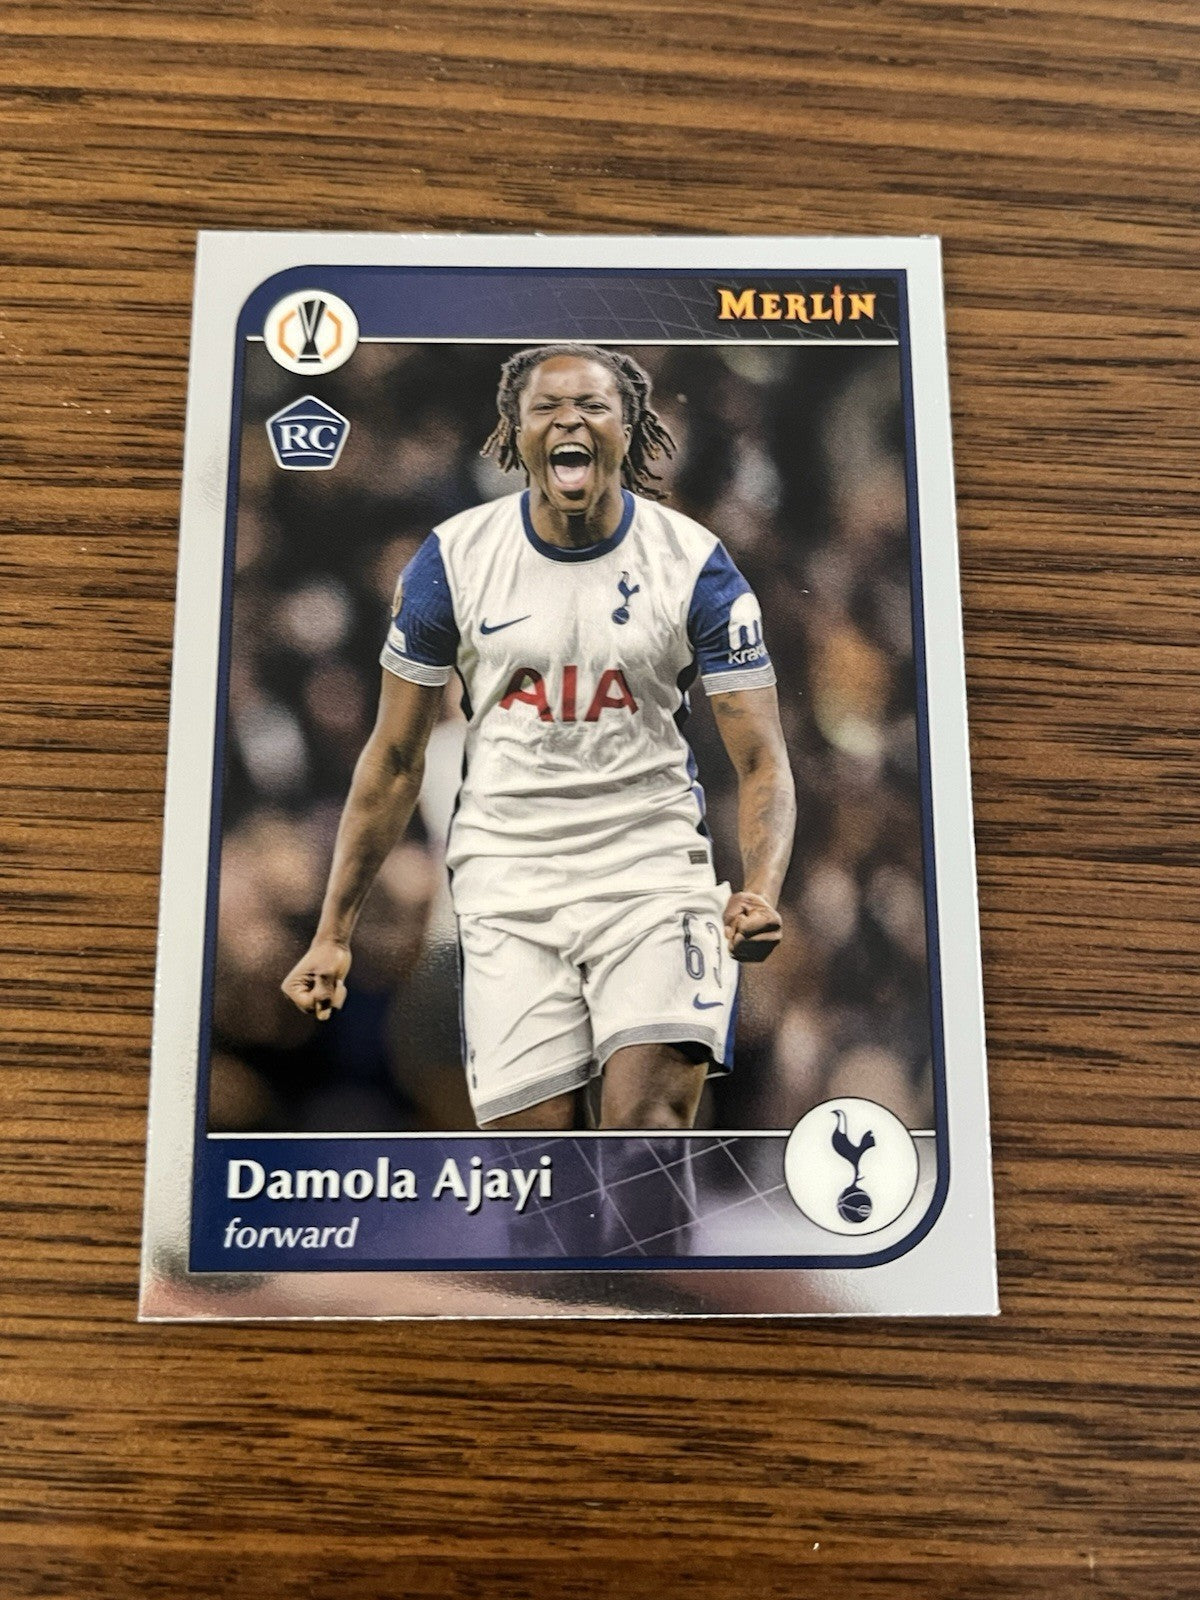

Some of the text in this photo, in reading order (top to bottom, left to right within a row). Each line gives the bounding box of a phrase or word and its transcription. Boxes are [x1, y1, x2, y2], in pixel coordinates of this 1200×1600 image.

[718, 284, 877, 326] MERLIN
[279, 424, 338, 451] RC
[498, 665, 639, 722] AIA
[227, 1155, 553, 1214] Damola Ajayi
[223, 1217, 360, 1249] forward
